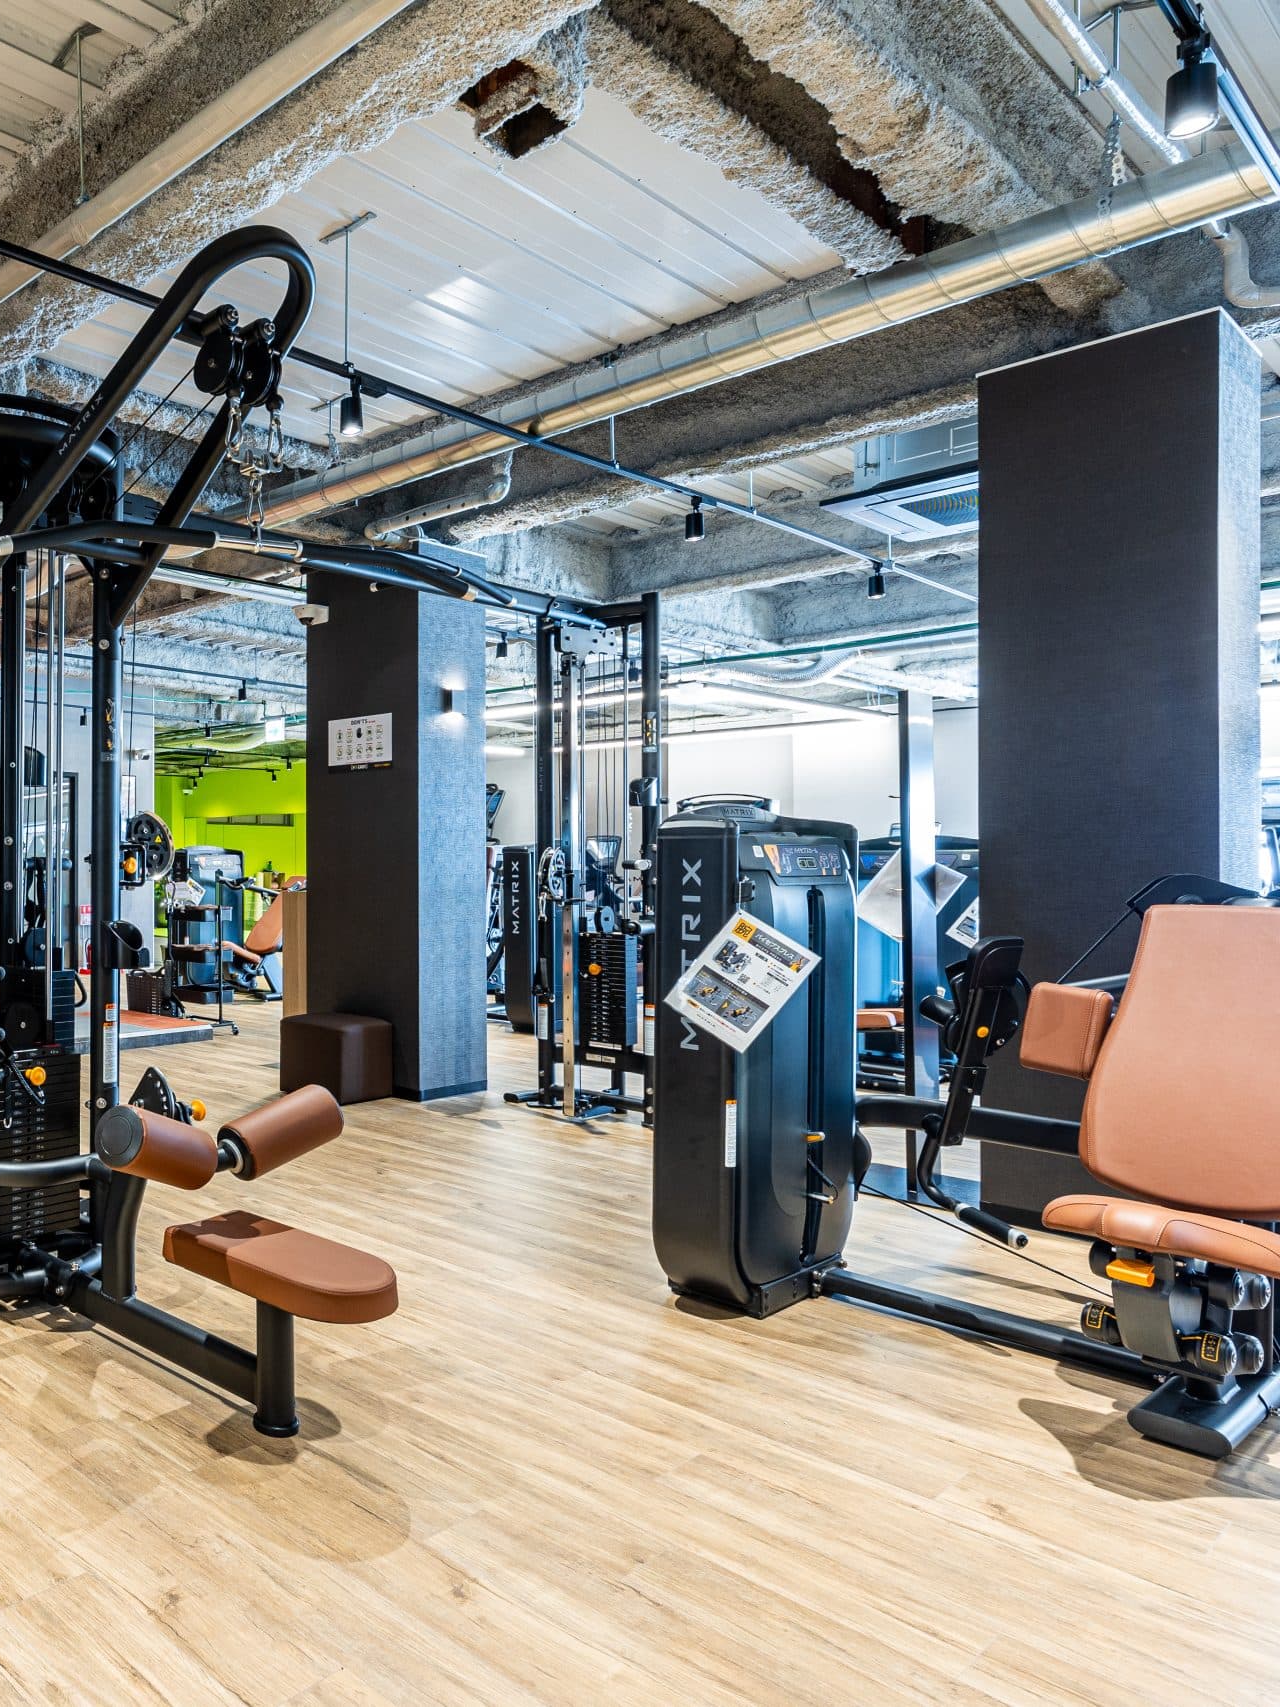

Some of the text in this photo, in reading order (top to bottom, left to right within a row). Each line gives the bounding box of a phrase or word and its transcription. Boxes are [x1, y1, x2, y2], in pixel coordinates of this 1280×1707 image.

[58, 392, 104, 456] MATRIX
[511, 860, 520, 935] MATRIX
[680, 857, 702, 1051] MTRIX
